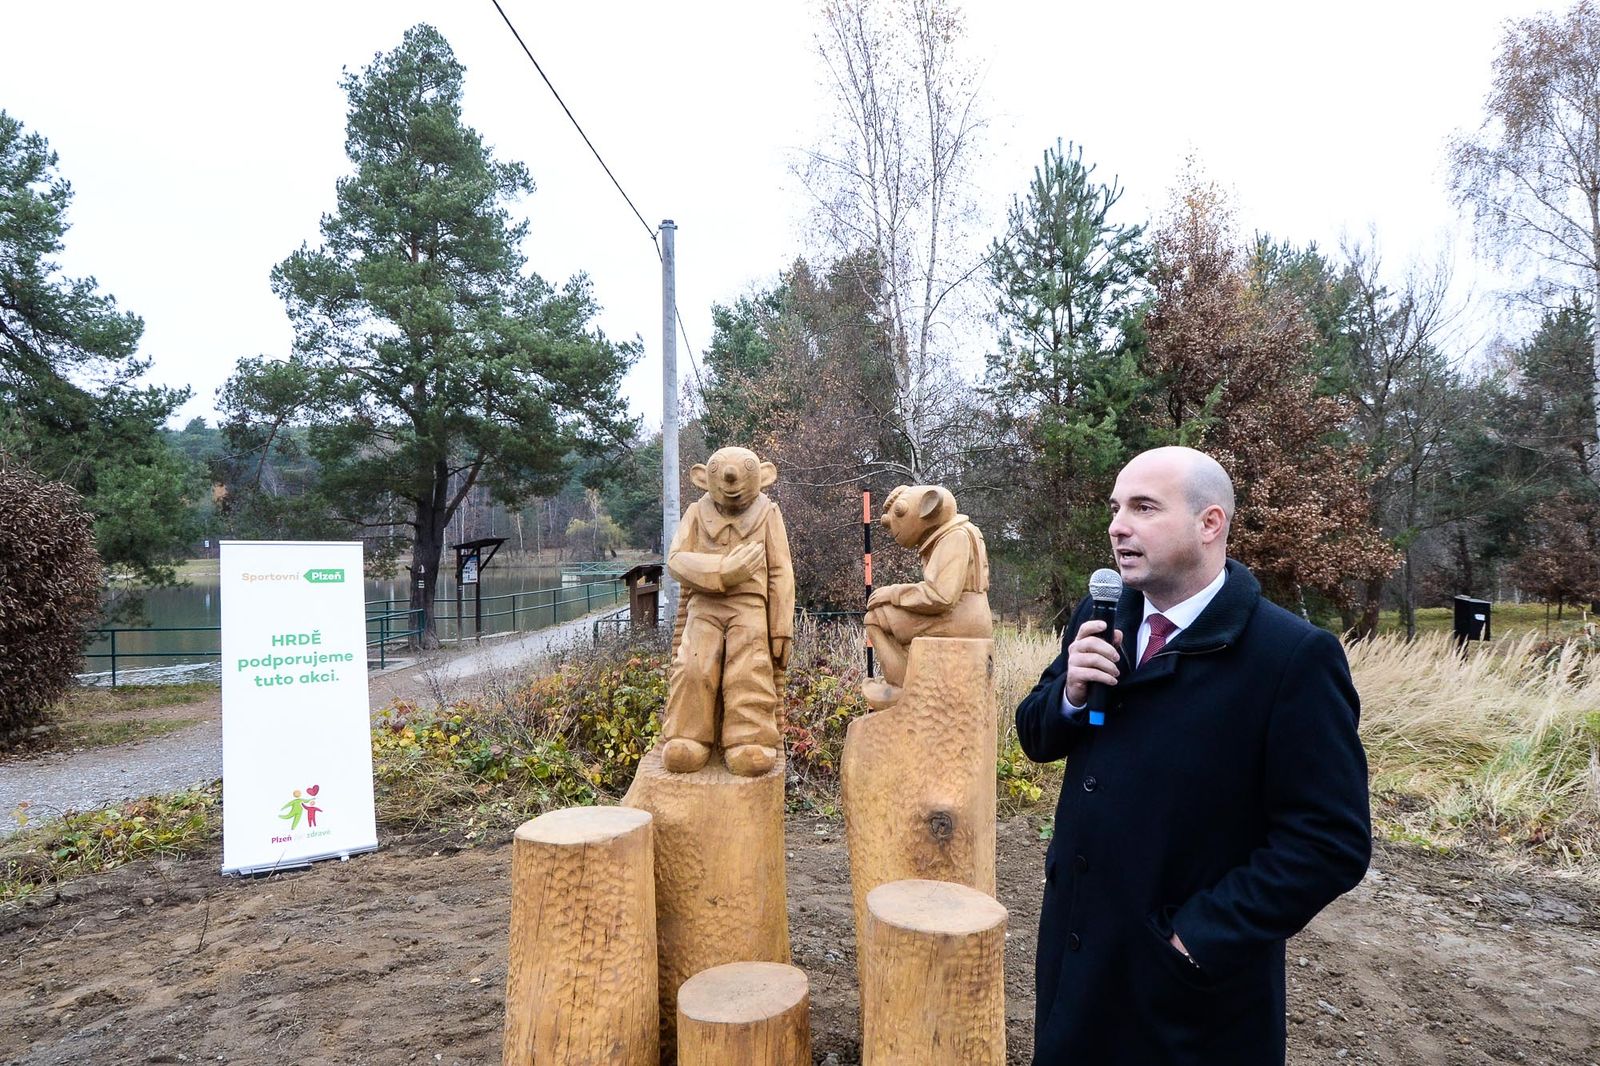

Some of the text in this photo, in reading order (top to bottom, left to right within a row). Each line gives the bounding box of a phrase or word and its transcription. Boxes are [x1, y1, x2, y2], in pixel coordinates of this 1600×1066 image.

[241, 570, 342, 583] Sportovní Plzeň
[271, 630, 322, 647] HRDĚ
[237, 651, 354, 672] podporujeme
[254, 669, 340, 687] tuto akci.
[271, 834, 292, 844] Plzeň
